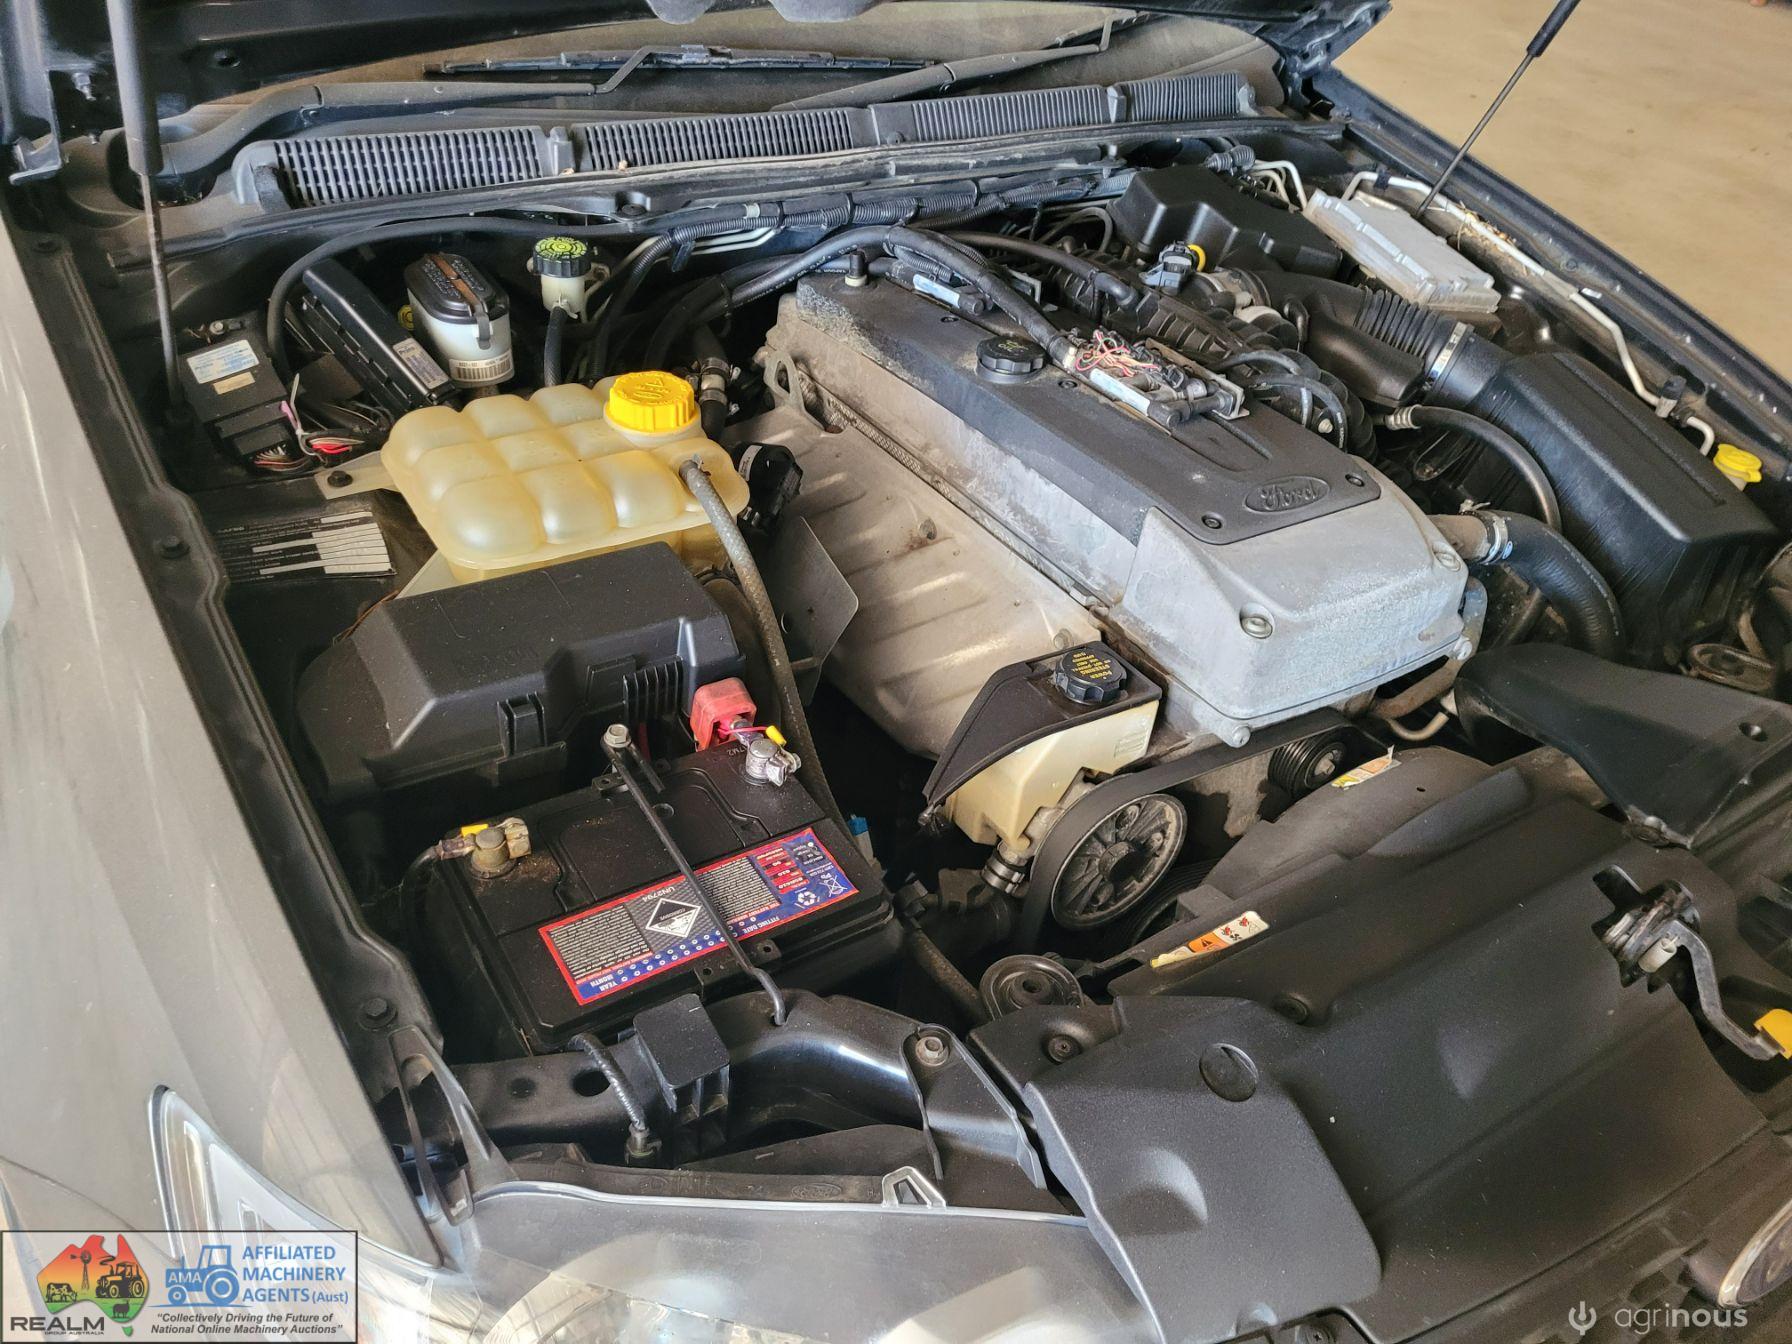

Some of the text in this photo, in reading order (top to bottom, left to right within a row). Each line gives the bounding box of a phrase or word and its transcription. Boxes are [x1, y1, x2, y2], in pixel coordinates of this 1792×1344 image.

[1259, 480, 1320, 511] Ford
[1080, 664, 1110, 675] STEERING
[1090, 670, 1112, 679] POWER
[757, 916, 780, 928] FITTING
[742, 924, 758, 934] DATE
[590, 973, 614, 987] MONTH
[599, 981, 618, 991] YEAR
